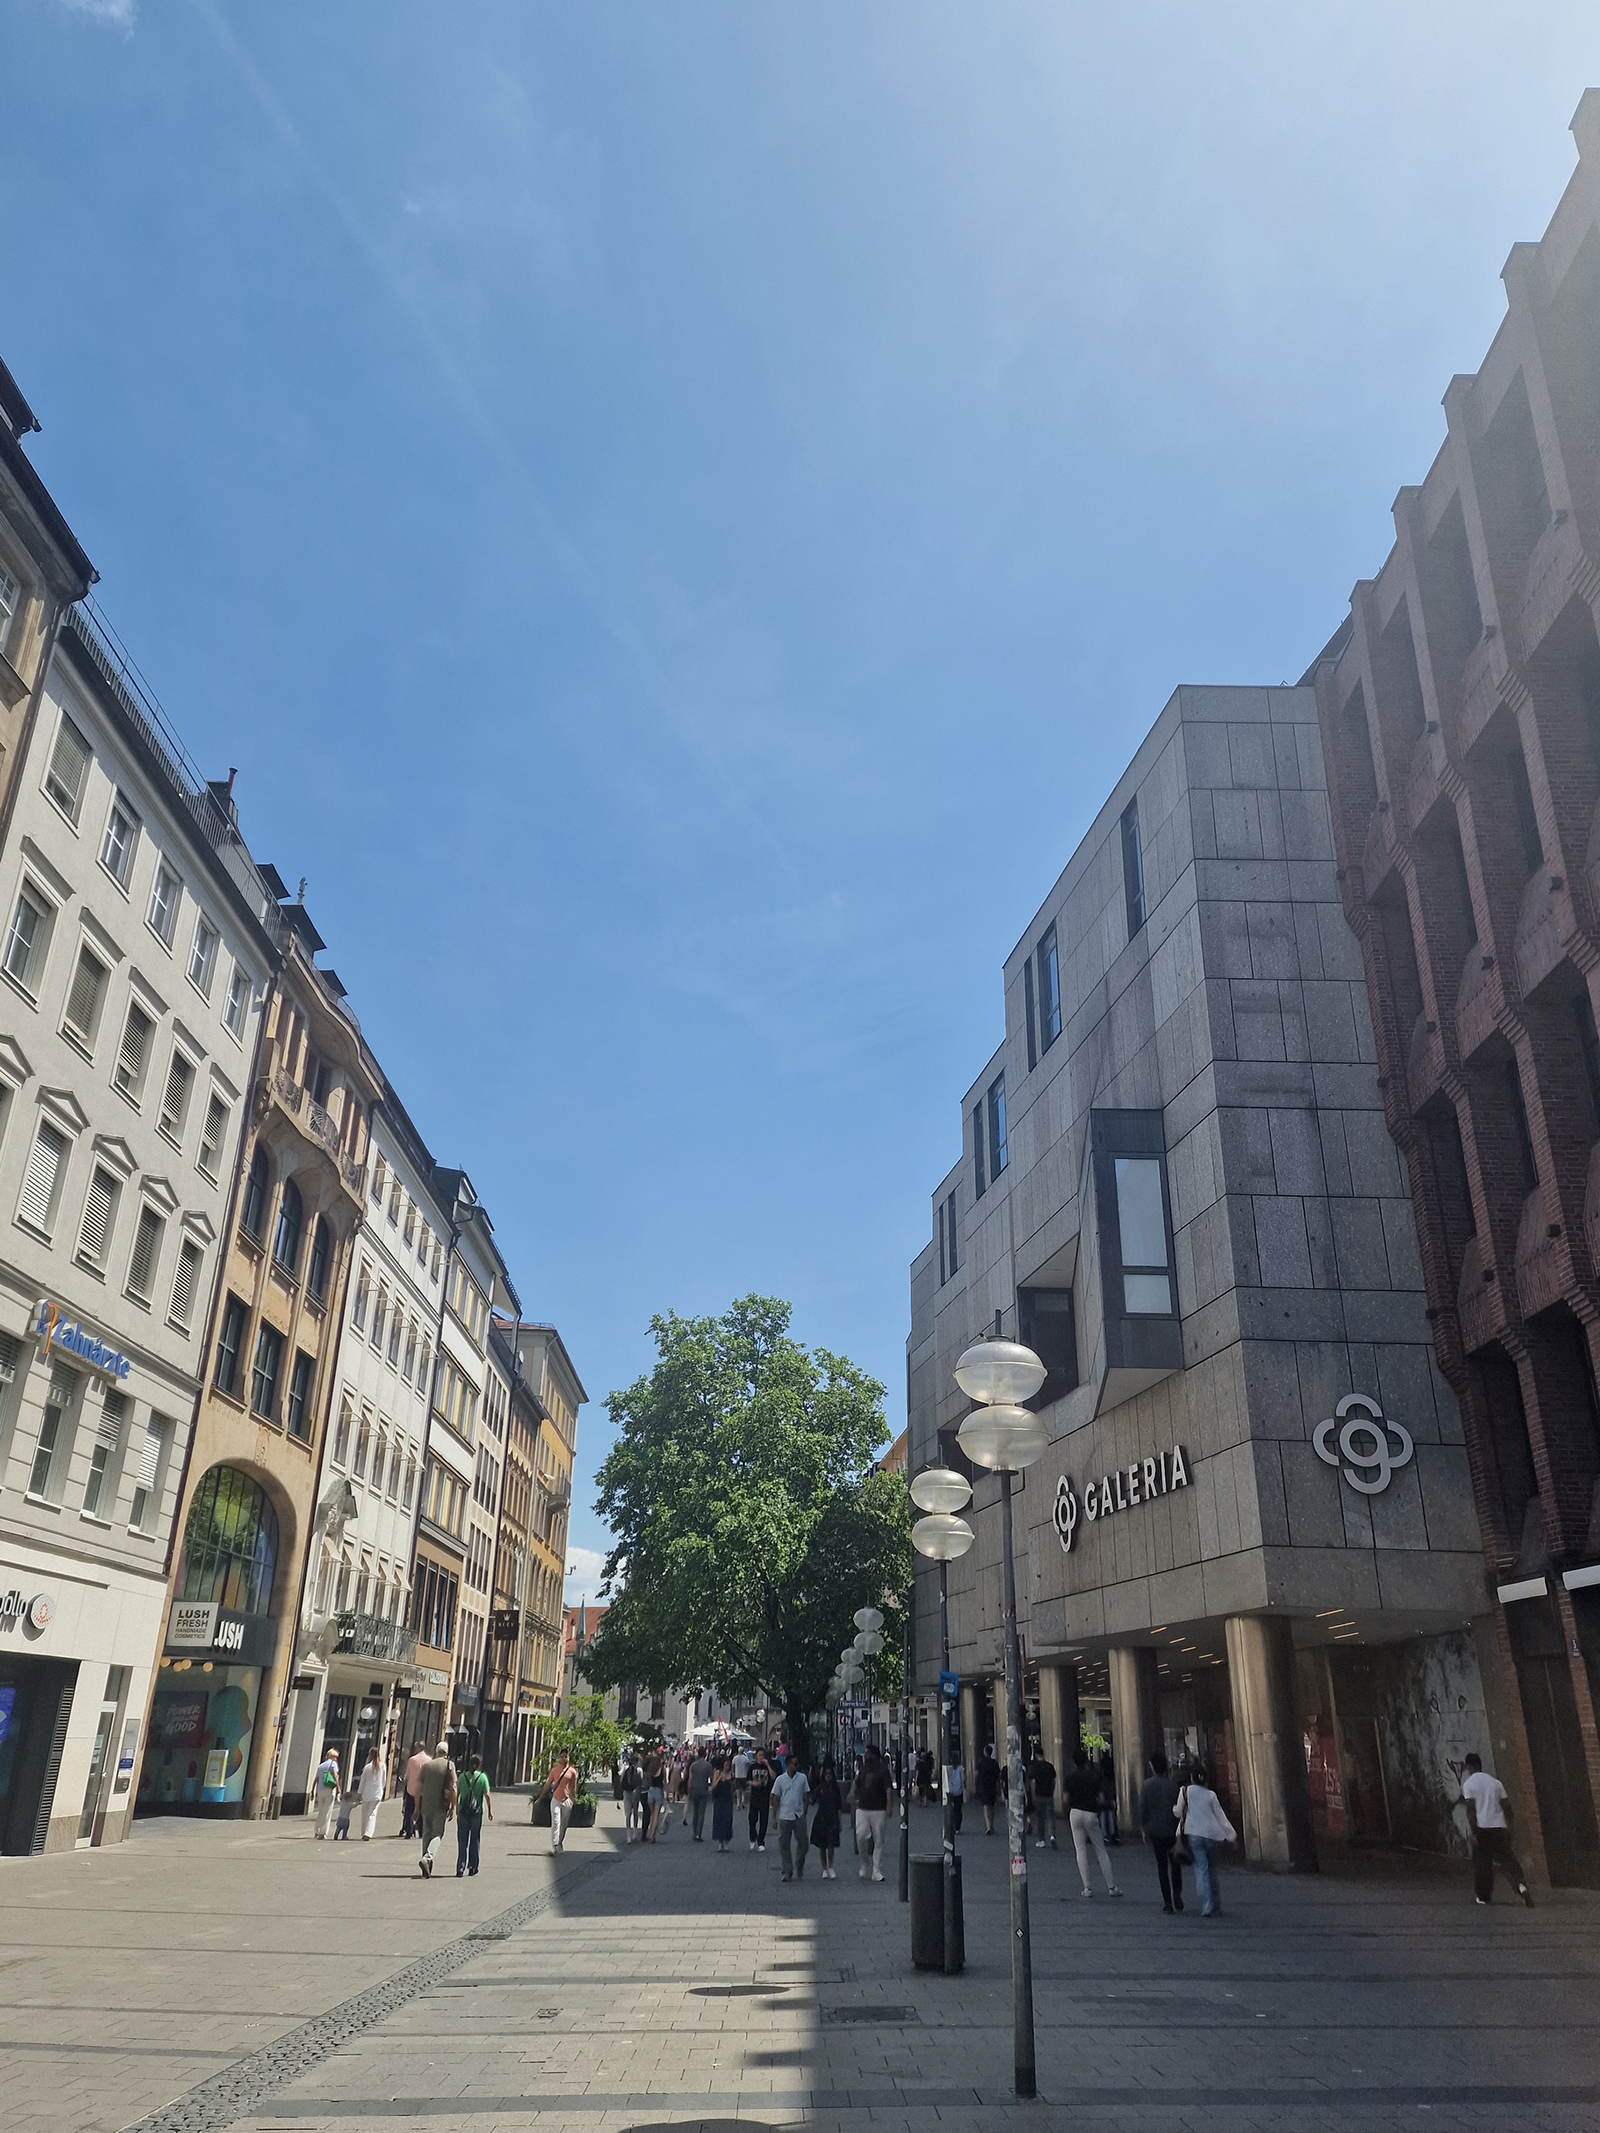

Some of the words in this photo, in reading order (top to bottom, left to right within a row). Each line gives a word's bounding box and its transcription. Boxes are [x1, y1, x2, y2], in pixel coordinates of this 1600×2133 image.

[1084, 1444, 1188, 1522] GALERIA
[176, 1619, 208, 1628] FRESH
[178, 1609, 210, 1619] LUSH
[213, 1620, 245, 1650] USH
